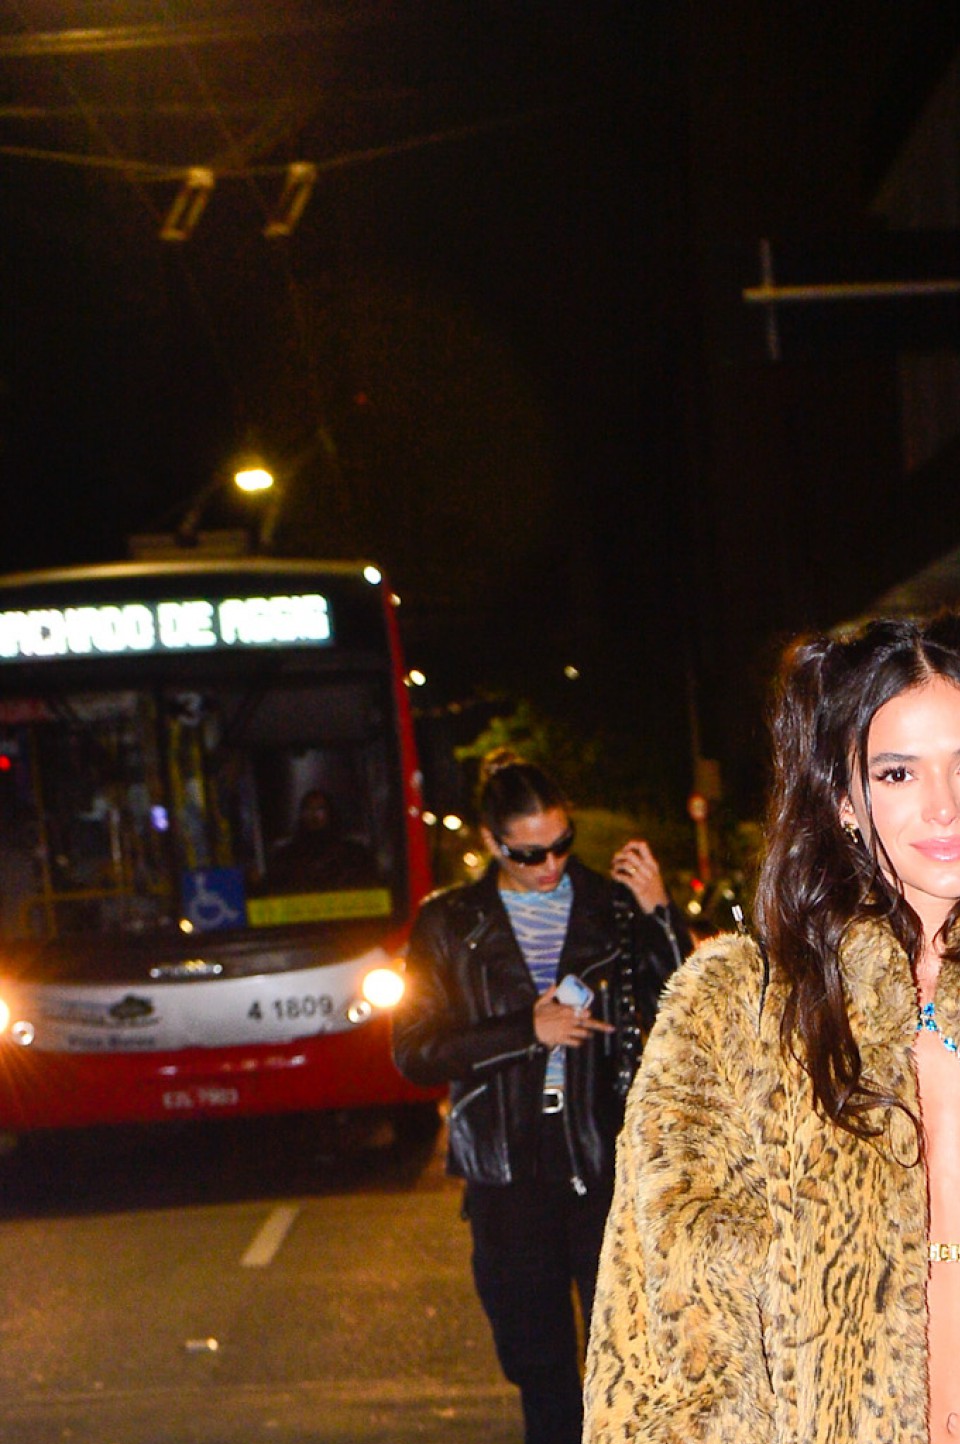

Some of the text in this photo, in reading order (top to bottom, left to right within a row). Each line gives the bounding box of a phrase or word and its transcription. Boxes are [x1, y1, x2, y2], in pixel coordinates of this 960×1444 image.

[0, 604, 155, 656] ACHADO
[158, 602, 216, 646] DE
[247, 993, 333, 1020] 4 1809
